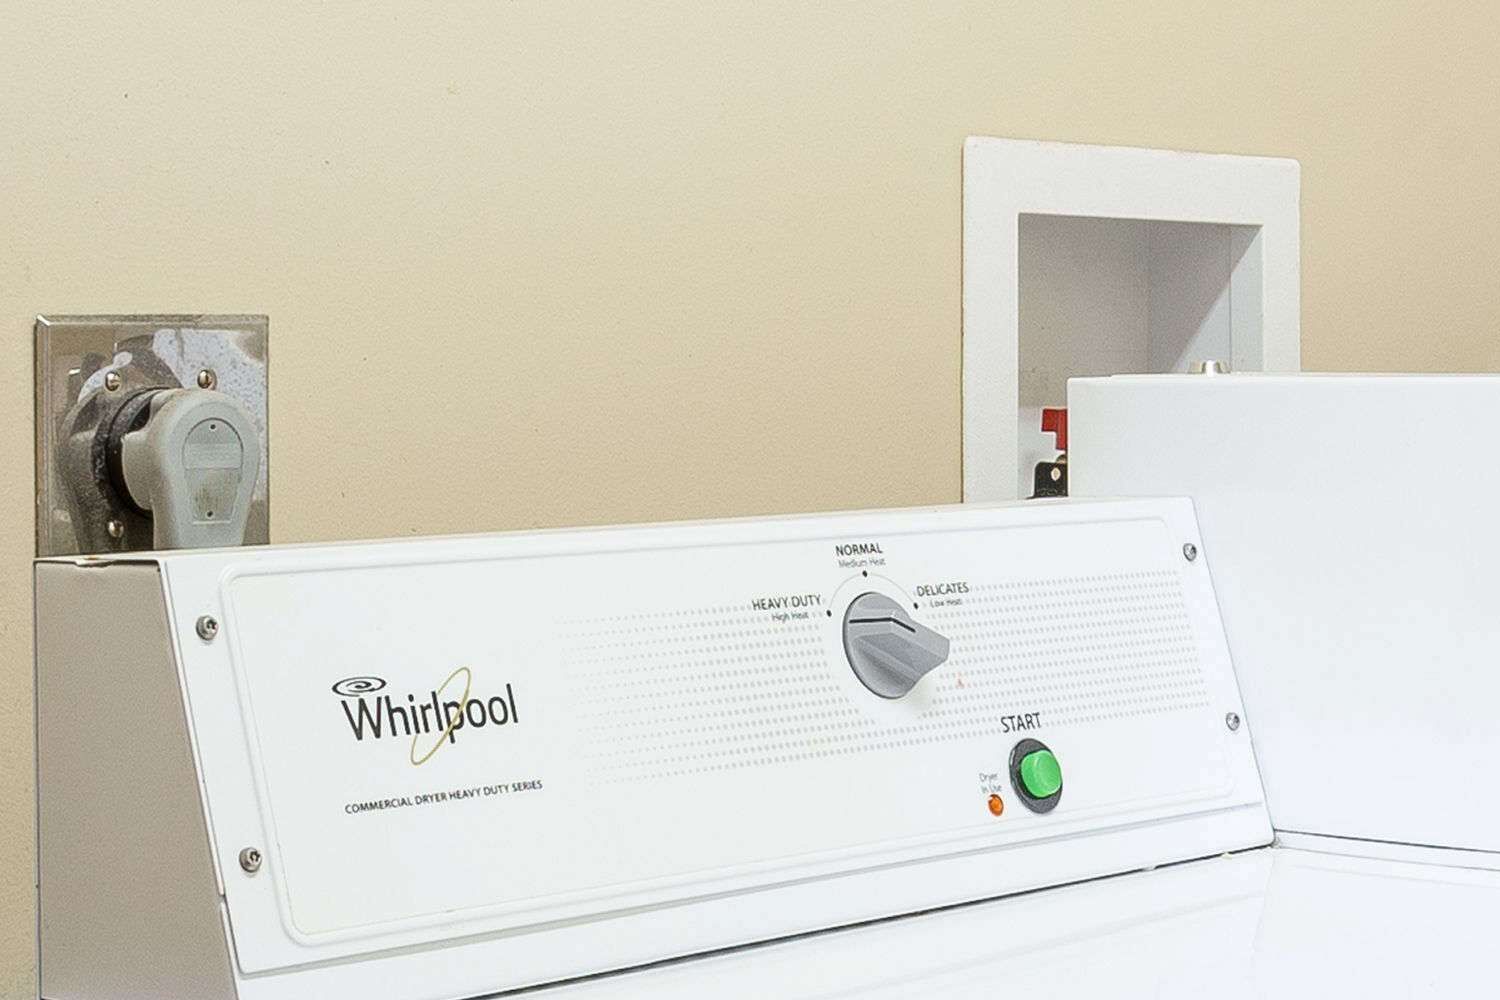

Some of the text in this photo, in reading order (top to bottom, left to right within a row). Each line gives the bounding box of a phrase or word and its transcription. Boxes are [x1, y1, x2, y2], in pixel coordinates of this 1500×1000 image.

[835, 543, 883, 557] NORMAL
[916, 581, 970, 597] DELICATES
[752, 594, 821, 611] HEAVY DUTY
[340, 683, 519, 744] Whirlpool
[1000, 712, 1042, 733] START
[344, 779, 543, 815] COMMERCIAL DRYER HEAVY DUTY SERIES
